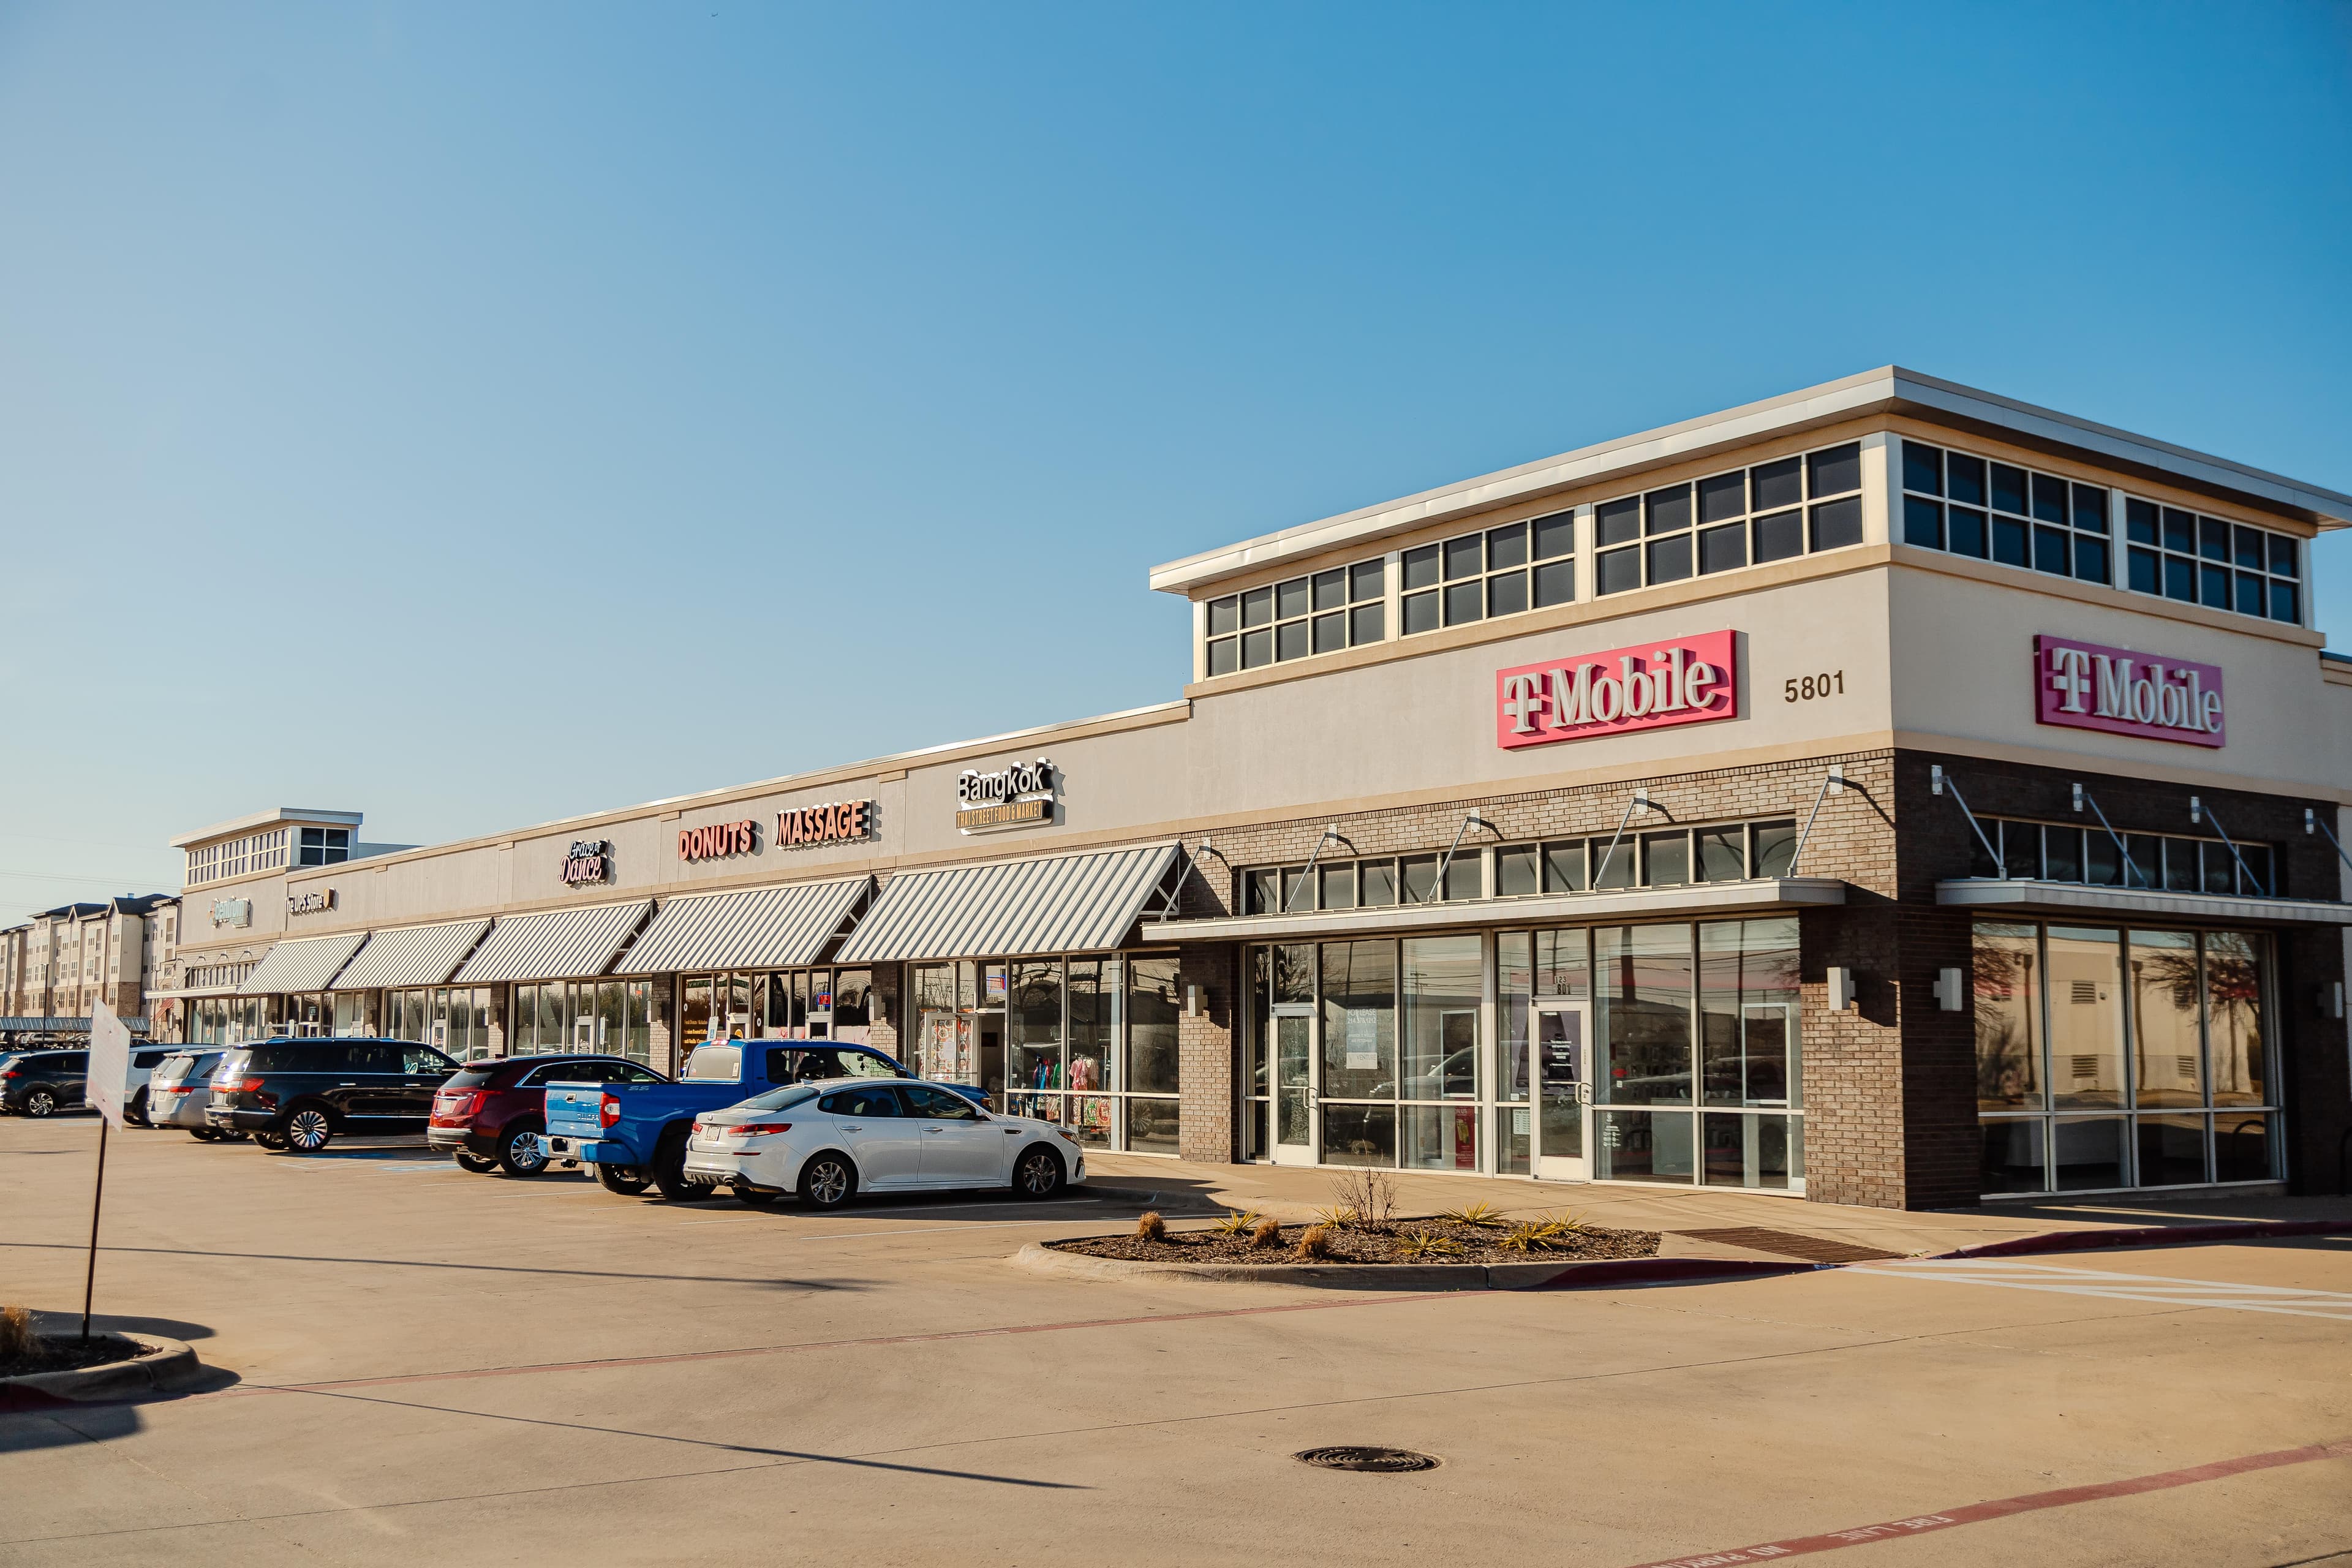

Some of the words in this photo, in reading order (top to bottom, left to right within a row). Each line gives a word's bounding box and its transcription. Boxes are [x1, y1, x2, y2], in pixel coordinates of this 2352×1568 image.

[1784, 669, 1845, 704] 5801
[956, 761, 1043, 804] Bangkok
[778, 801, 864, 846] MASSAGE
[957, 812, 970, 827] THAI
[971, 808, 993, 826] STREET
[995, 805, 1010, 822] FOOD
[1011, 807, 1016, 821] &
[1017, 801, 1042, 819] MARKET
[570, 841, 595, 859] Grace
[594, 842, 601, 853] of
[678, 820, 752, 861] DONUTS
[558, 855, 601, 883] Dance
[285, 897, 294, 913] The
[295, 894, 307, 911] UPS
[307, 893, 323, 911] Store
[1827, 1526, 1901, 1541] LANE
[1893, 1515, 1955, 1529] FIRE
[1747, 1544, 1794, 1557] NO
